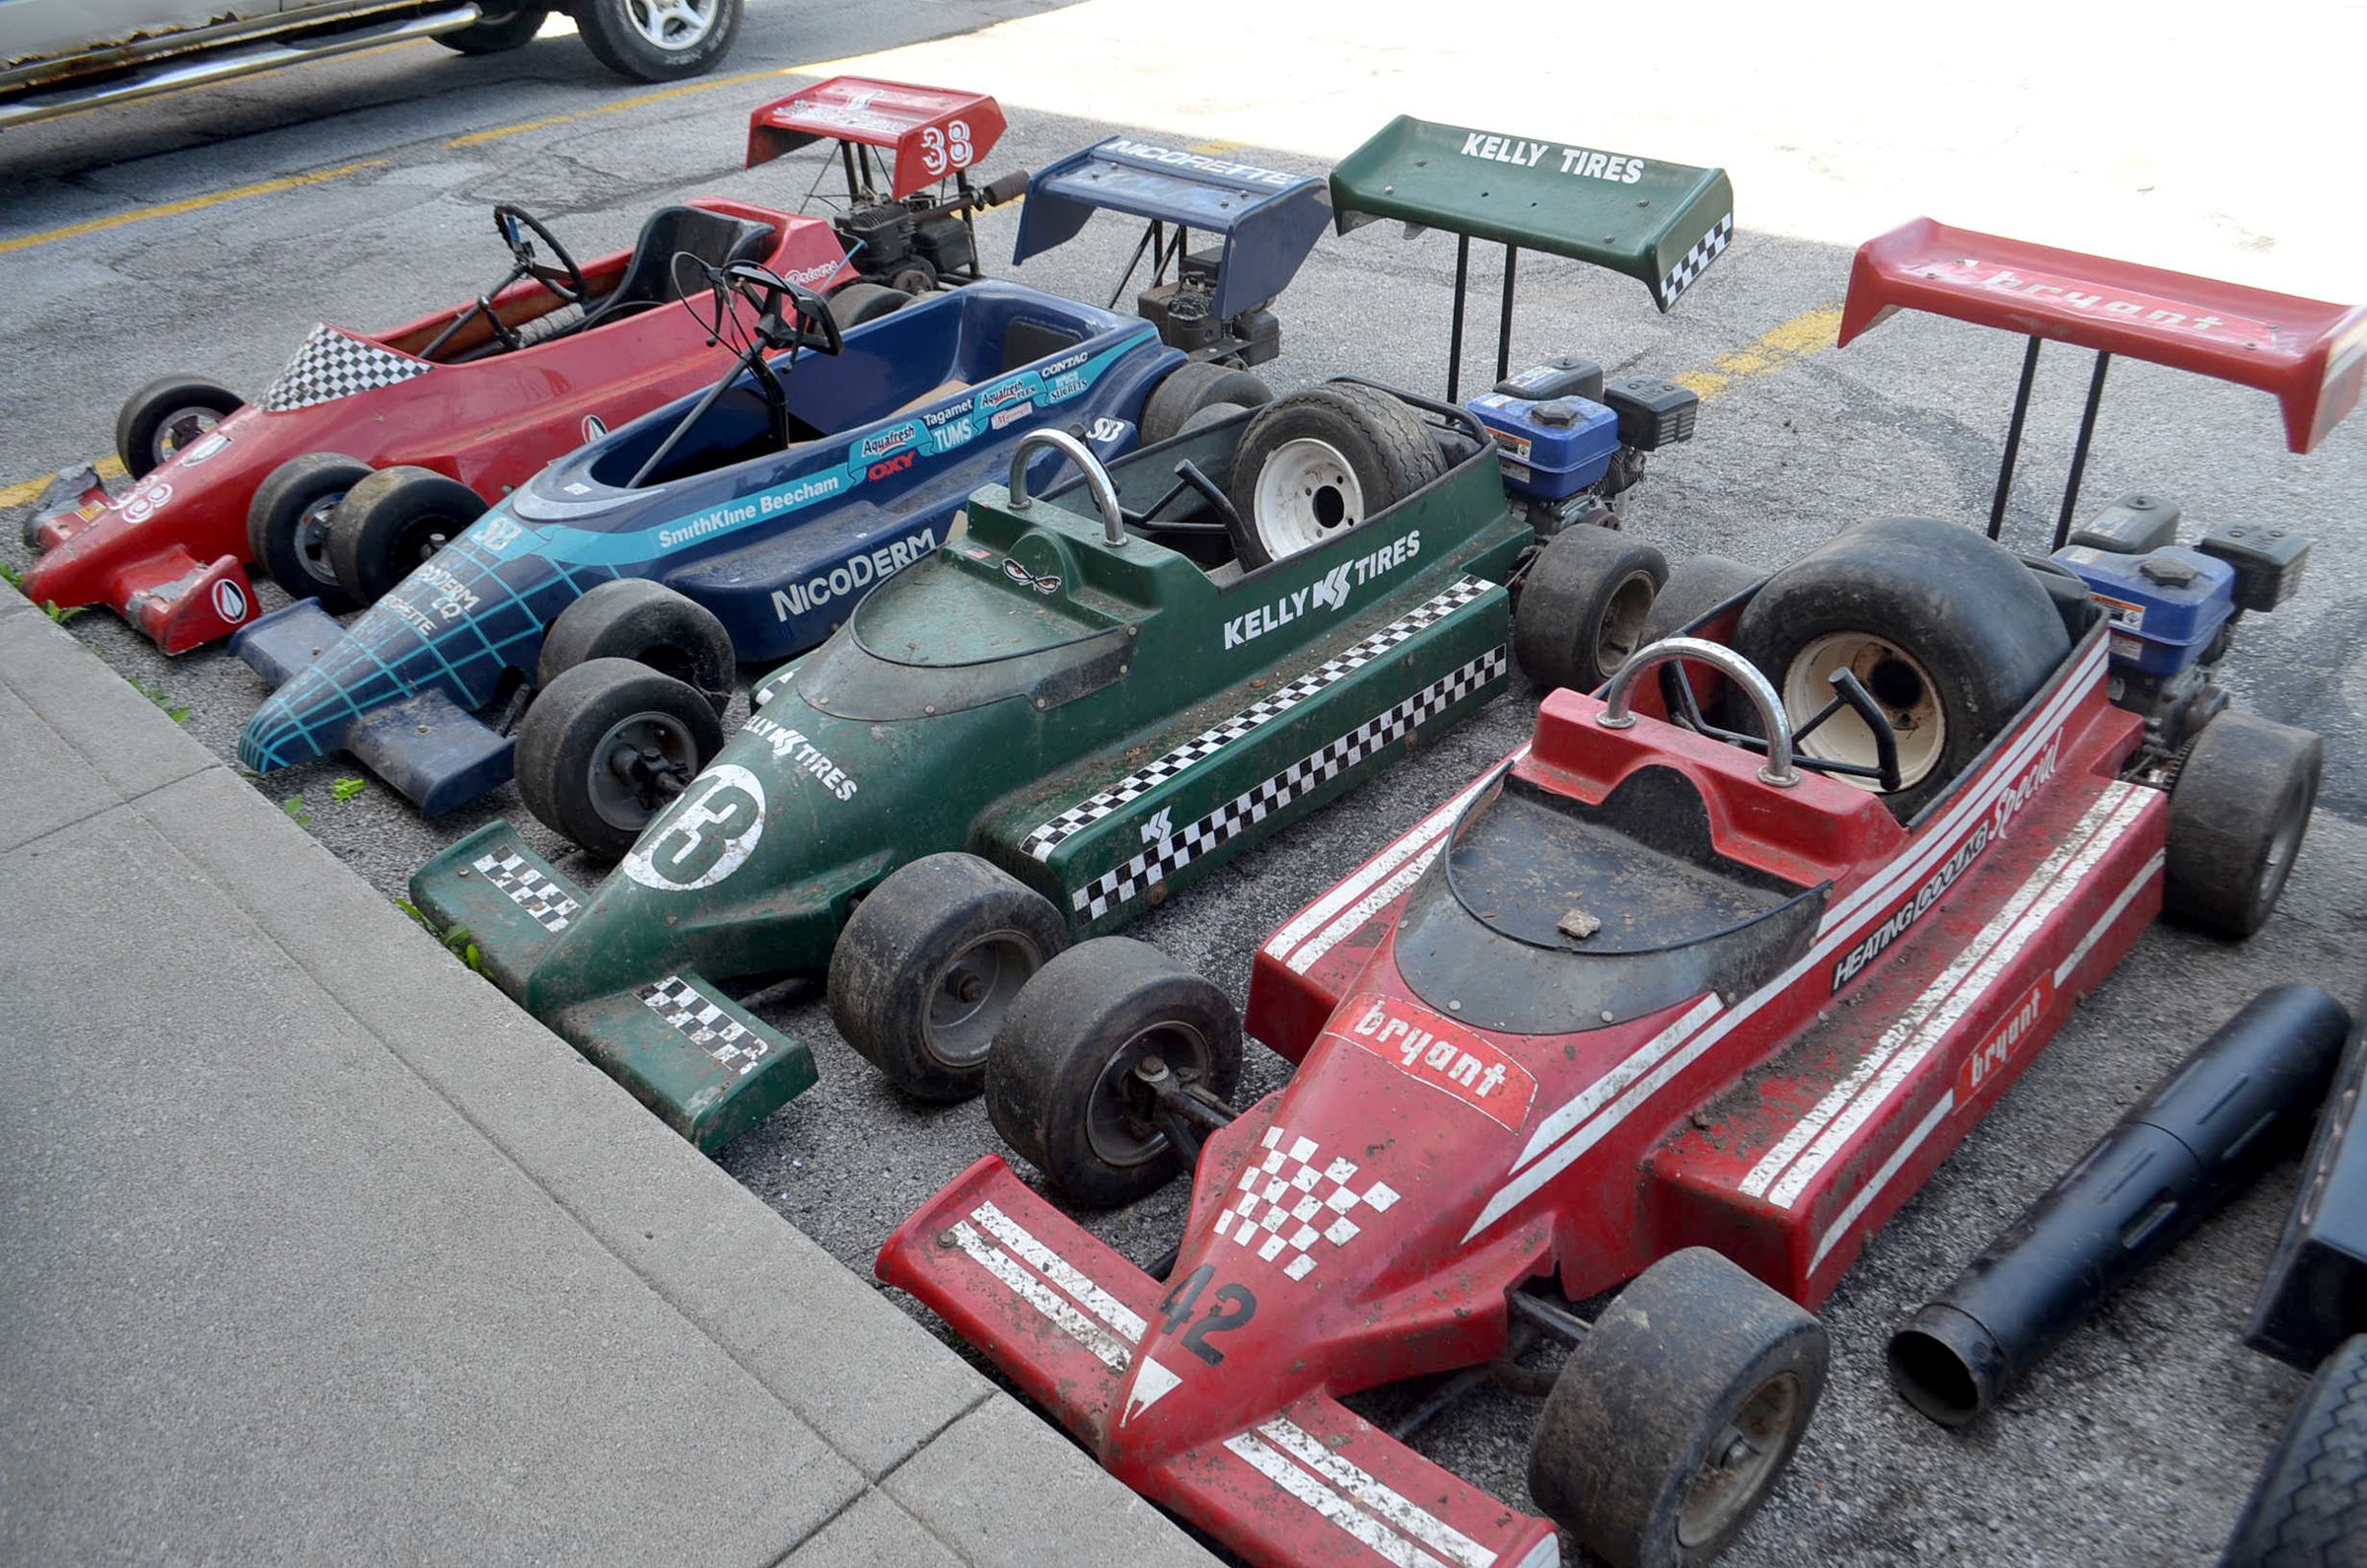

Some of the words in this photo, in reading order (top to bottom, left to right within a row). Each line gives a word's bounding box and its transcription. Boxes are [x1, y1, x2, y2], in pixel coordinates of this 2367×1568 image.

[920, 119, 973, 176] 38
[1106, 139, 1297, 185] NICORETTE
[1461, 132, 1549, 168] KELLY
[1560, 148, 1645, 184] TIRES
[1980, 269, 2224, 333] bryant
[981, 377, 1023, 410] Aquafresh
[1041, 351, 1089, 378] CONTAC
[861, 422, 915, 459] Aquafresh
[923, 398, 973, 426] Tagamet
[934, 418, 972, 452] TUMS
[868, 451, 915, 481] OXY
[659, 504, 756, 548] SmithKline
[759, 476, 839, 514] Beecham
[771, 528, 937, 622] NICODERM
[1223, 587, 1309, 651] KELLY
[1354, 530, 1420, 586] TIRES
[742, 714, 779, 737] ELLY
[794, 743, 858, 802] TIRES
[1833, 902, 1914, 990] HEATING
[1989, 726, 2063, 839] Special
[1354, 1000, 1507, 1099] bryant
[1971, 987, 2042, 1089] bryant
[1157, 1263, 1257, 1368] 42
